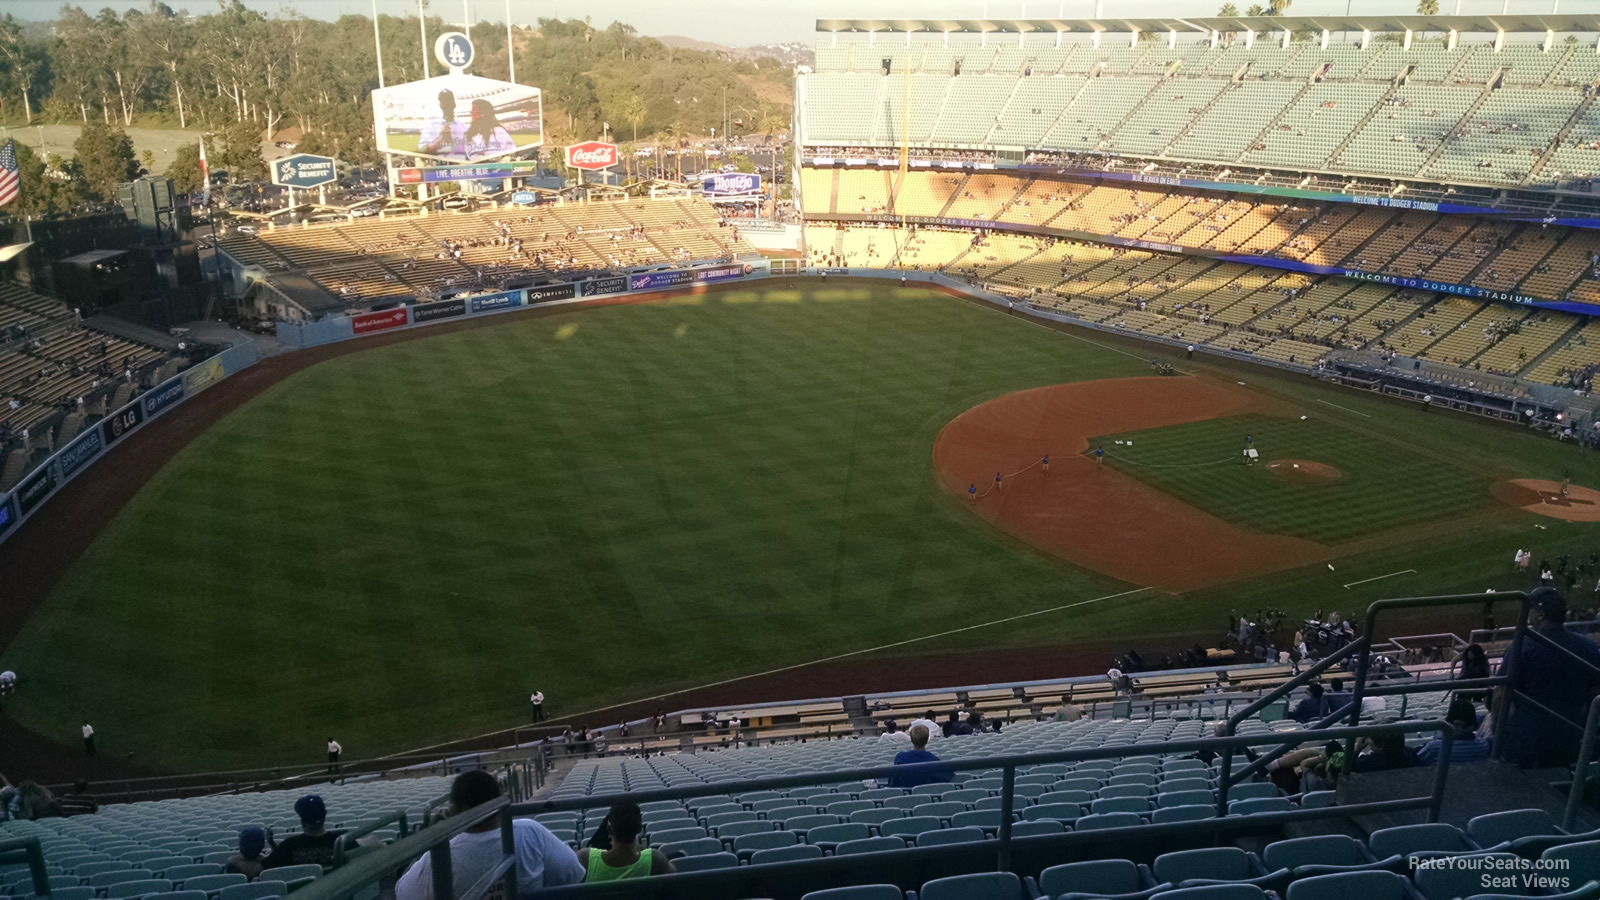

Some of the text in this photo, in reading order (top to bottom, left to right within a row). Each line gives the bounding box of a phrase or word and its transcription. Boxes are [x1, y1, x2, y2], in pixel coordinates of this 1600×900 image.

[448, 38, 466, 63] LA
[572, 147, 613, 164] Coca-Cola
[297, 161, 331, 170] SECURITY
[298, 170, 328, 178] BENEFIT
[436, 170, 450, 178] LIVE.
[450, 169, 475, 178] BREATHE.
[1352, 195, 1439, 211] WELCOME TO DODGER STADIUM
[707, 269, 729, 278] COMMUNITY
[729, 267, 741, 275] NIGHT
[596, 278, 624, 288] SECURITY
[1345, 270, 1533, 304] WELCOME TO DODGER STADIUM
[542, 290, 573, 298] INFINITI
[596, 286, 620, 295] BENEFIT
[421, 308, 434, 317] Time
[433, 307, 450, 315] Warner
[450, 304, 464, 312] Cable
[354, 321, 367, 329] Bank
[372, 316, 393, 326] America
[157, 384, 183, 404] HYUNDAI
[122, 410, 136, 429] LG
